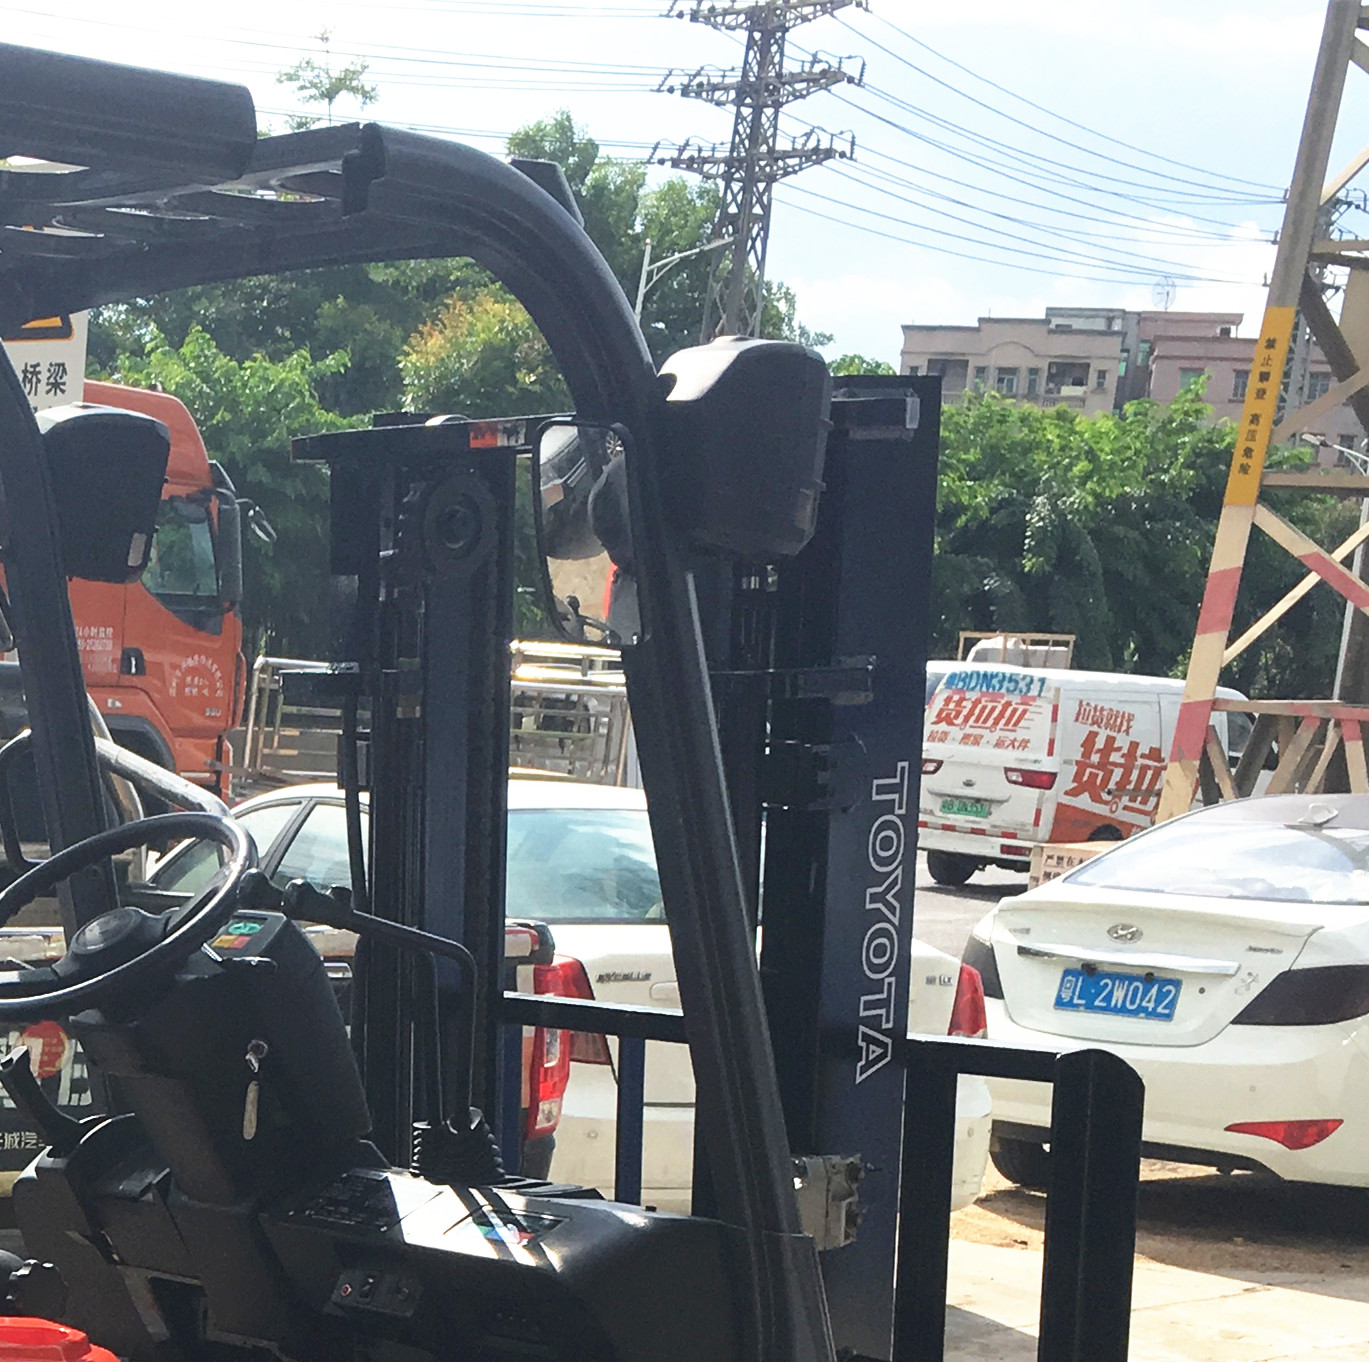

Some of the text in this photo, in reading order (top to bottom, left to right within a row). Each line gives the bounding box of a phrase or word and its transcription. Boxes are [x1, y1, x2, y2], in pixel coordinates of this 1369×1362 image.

[22, 362, 68, 396] 桥梁
[931, 695, 1031, 732] 货拉拉
[1063, 730, 1170, 826] 货拉
[855, 761, 909, 1085] TOYOTA
